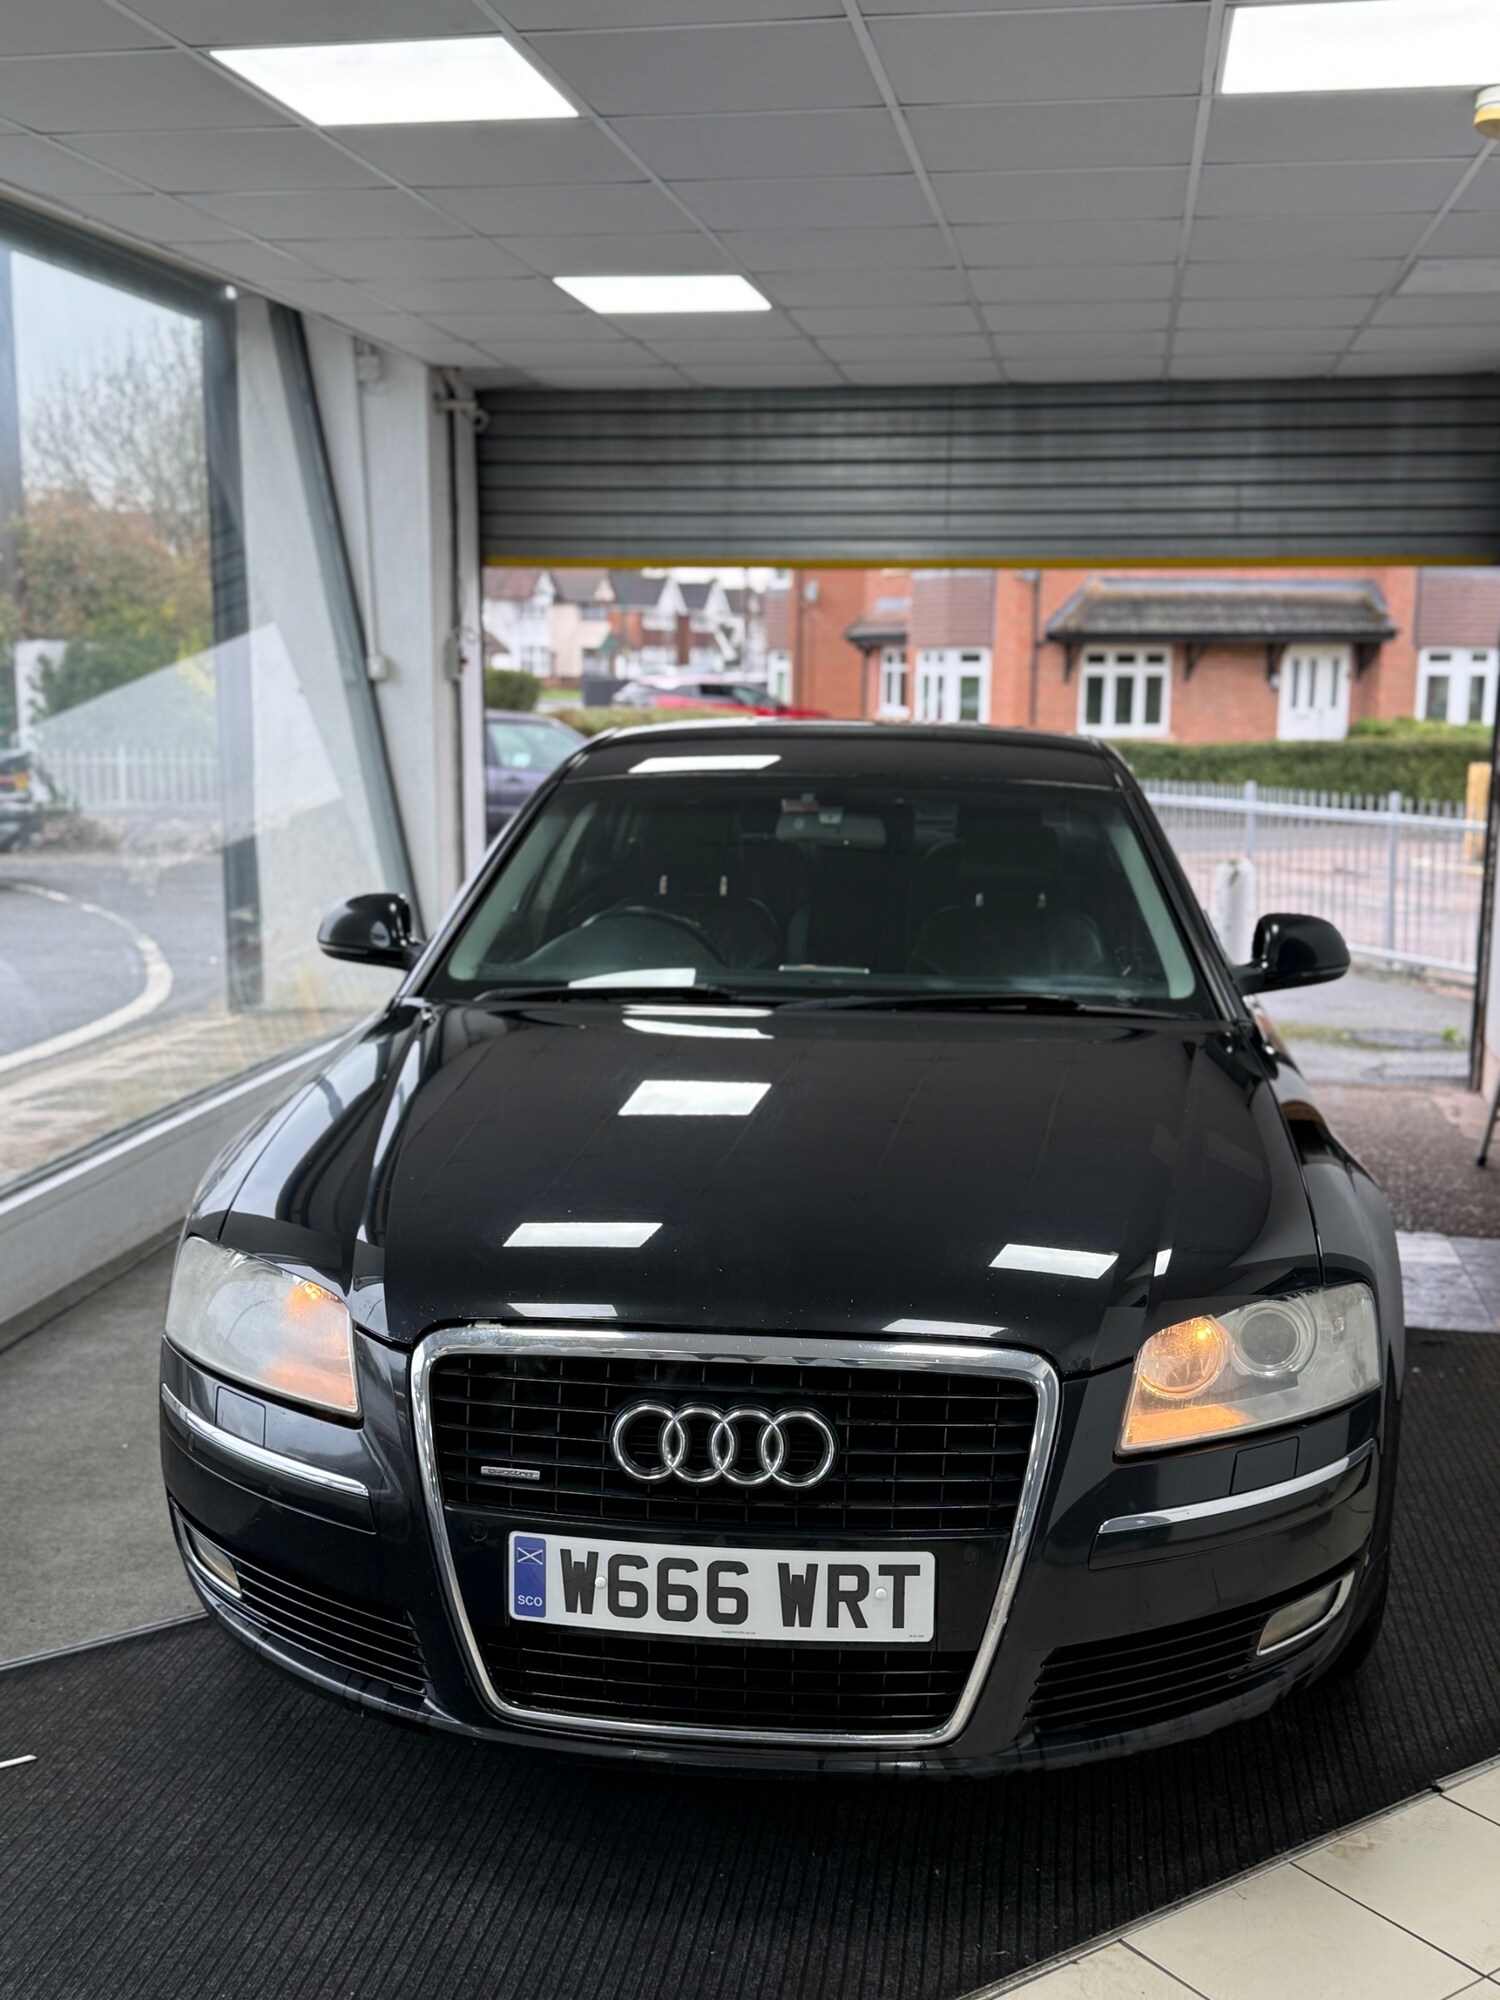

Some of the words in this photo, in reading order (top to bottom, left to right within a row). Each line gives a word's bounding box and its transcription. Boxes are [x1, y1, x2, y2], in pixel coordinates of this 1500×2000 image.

[517, 1595, 543, 1607] SCO
[559, 1548, 749, 1625] W666
[777, 1562, 921, 1629] WRT
